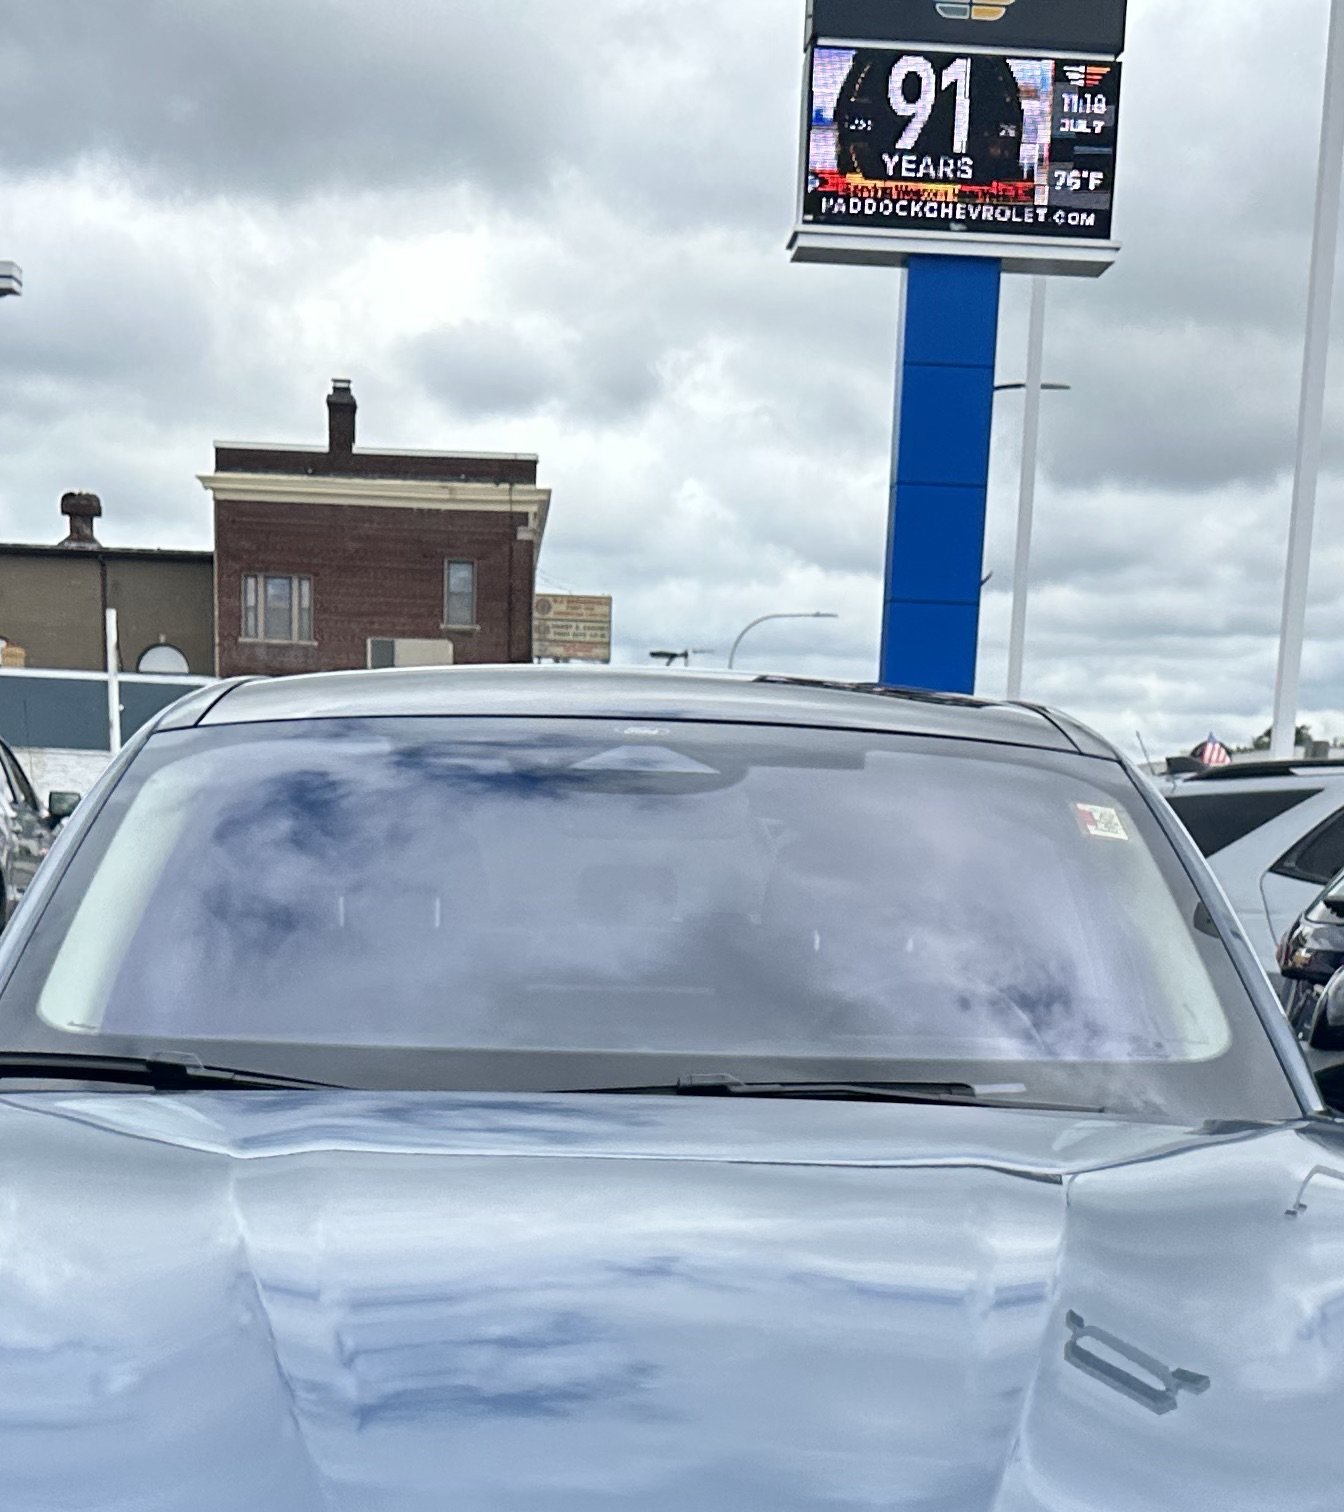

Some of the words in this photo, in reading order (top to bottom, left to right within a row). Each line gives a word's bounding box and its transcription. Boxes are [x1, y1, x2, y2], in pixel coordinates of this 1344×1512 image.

[887, 54, 972, 154] 91
[881, 152, 975, 180] YEARS
[821, 196, 1096, 227] PADDOCKCHEVROLET.COM
